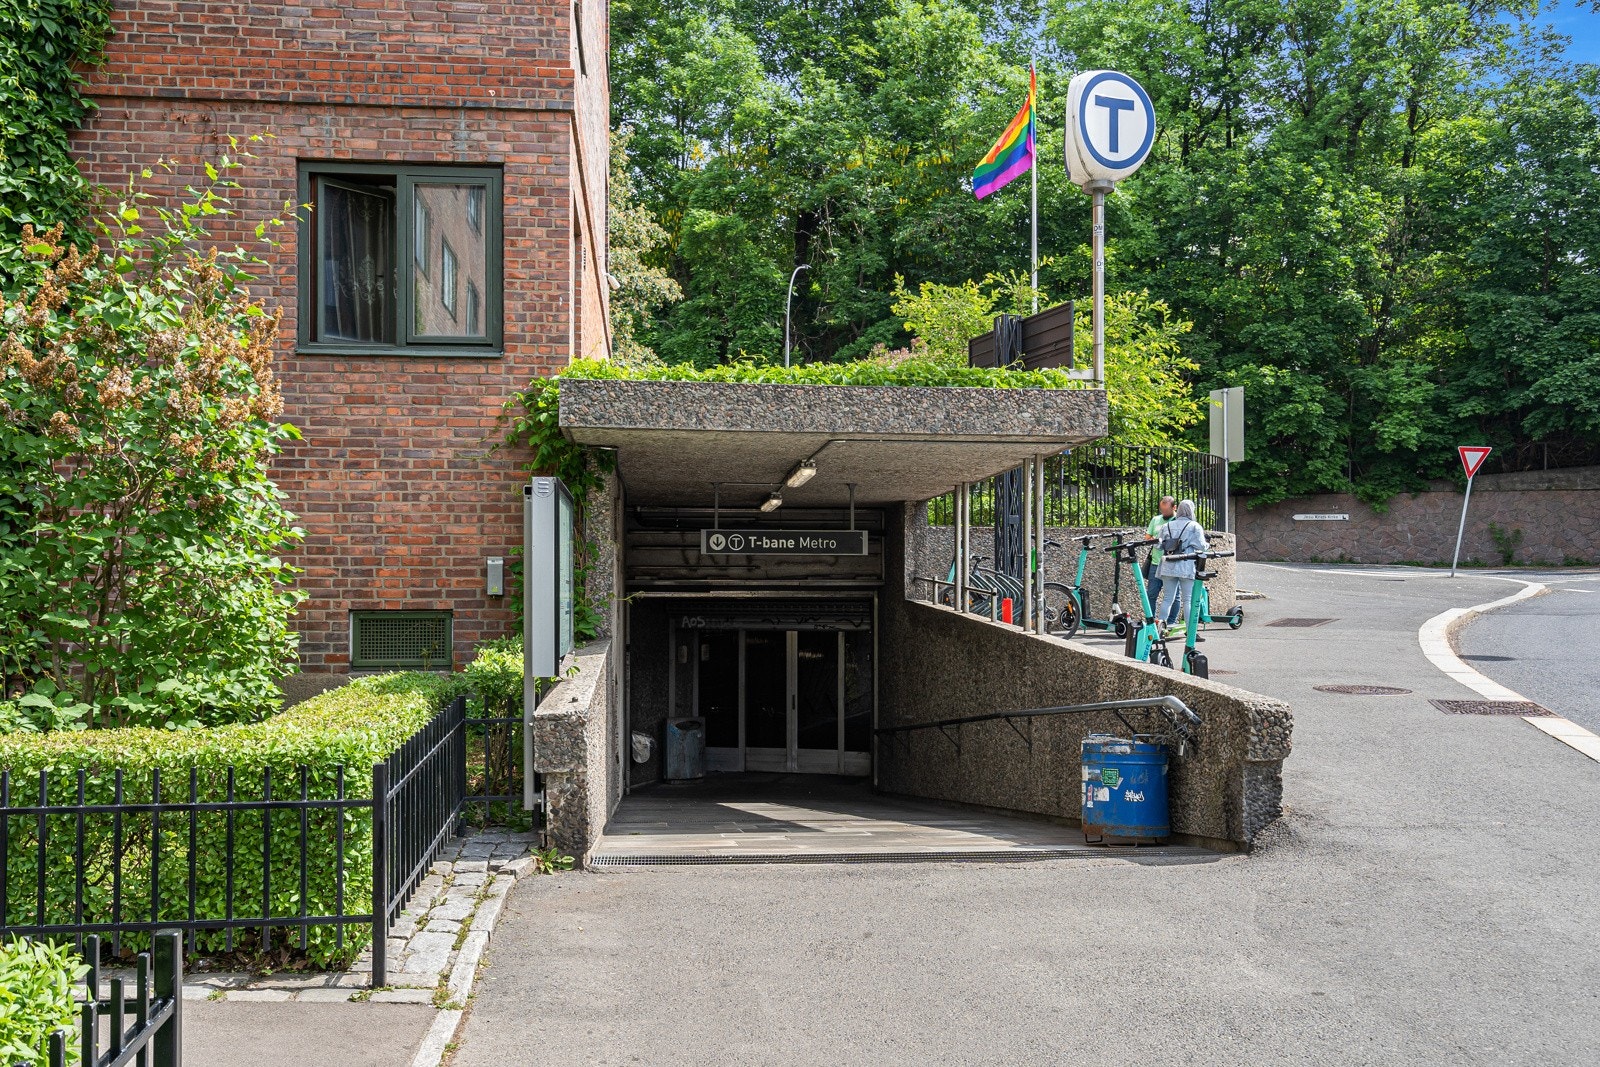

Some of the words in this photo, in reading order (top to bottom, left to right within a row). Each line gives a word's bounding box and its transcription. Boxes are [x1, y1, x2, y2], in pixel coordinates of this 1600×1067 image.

[1095, 95, 1134, 153] T
[732, 538, 741, 549] T
[749, 536, 795, 548] T-bane
[799, 536, 837, 549] Metro
